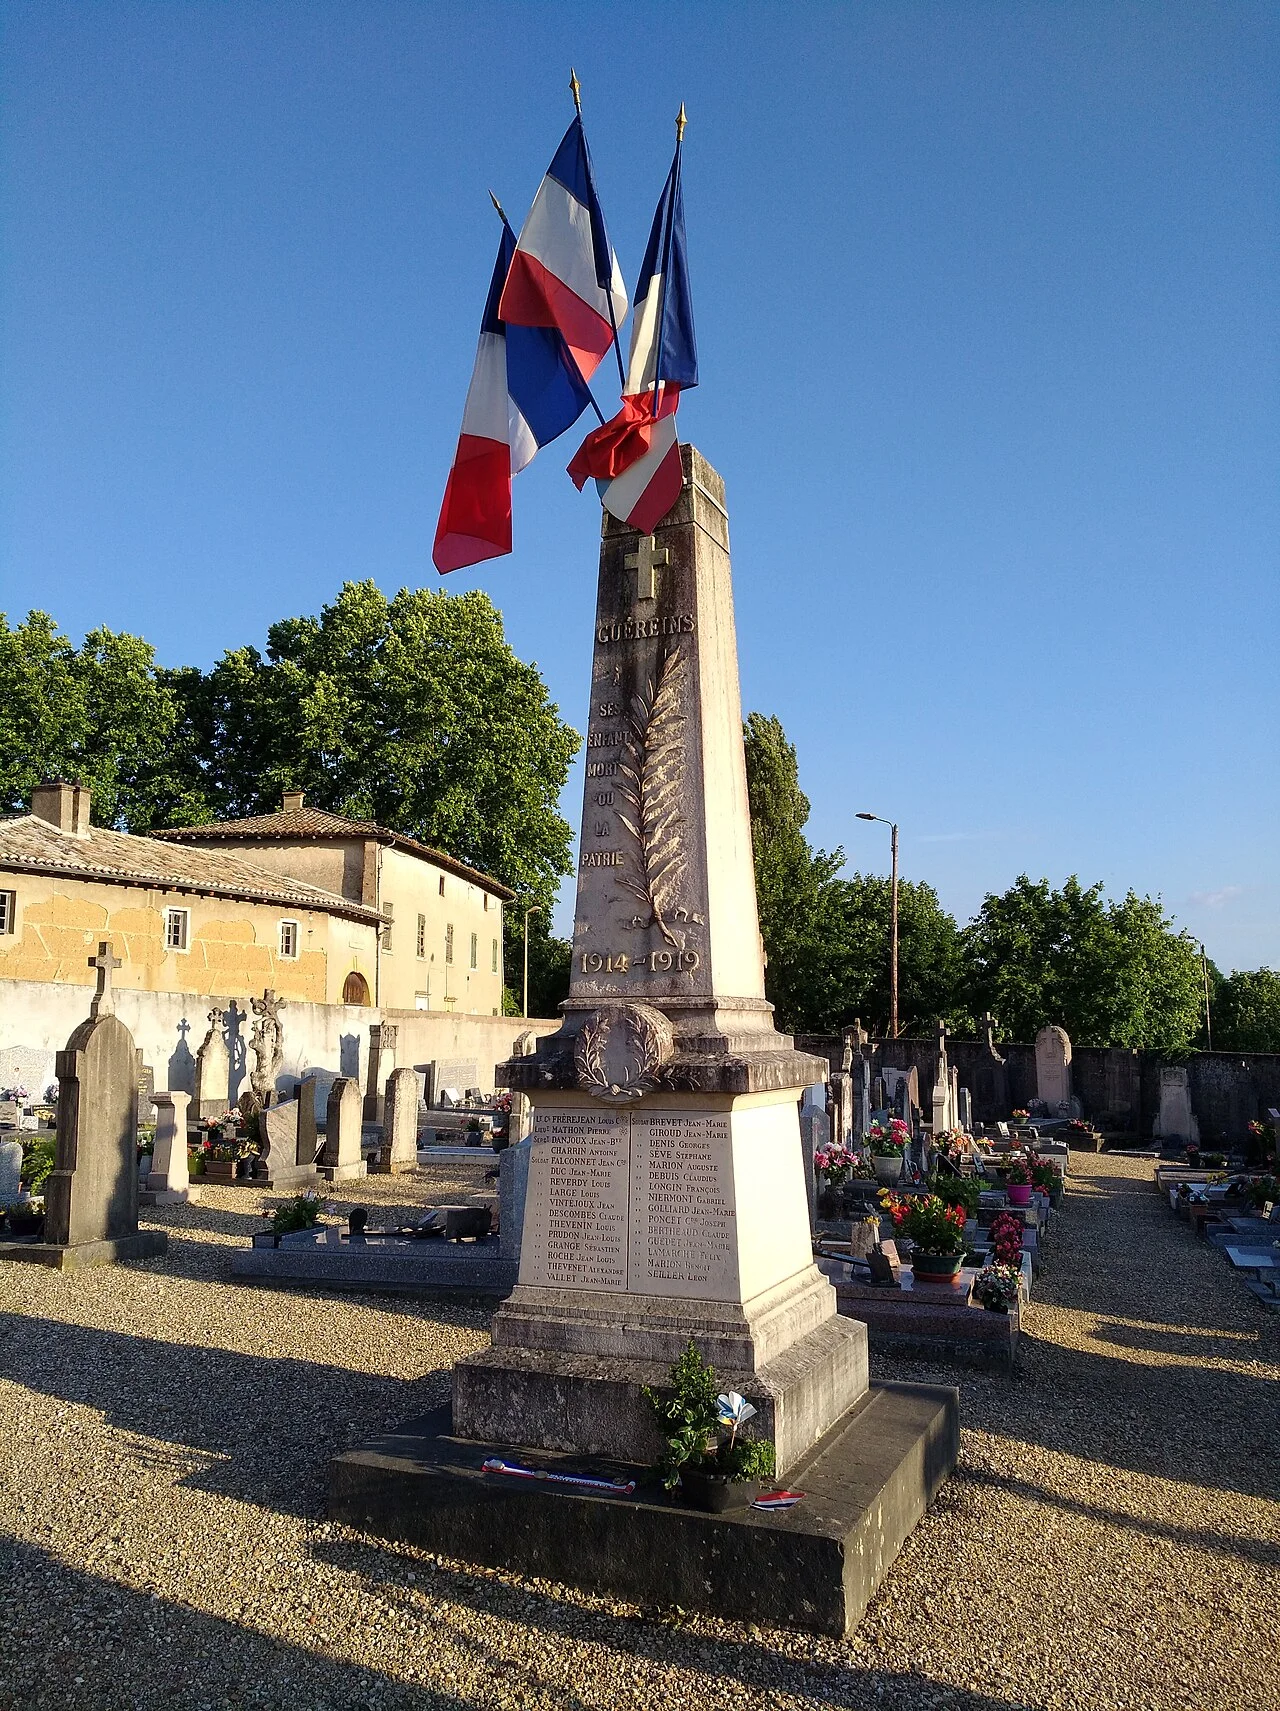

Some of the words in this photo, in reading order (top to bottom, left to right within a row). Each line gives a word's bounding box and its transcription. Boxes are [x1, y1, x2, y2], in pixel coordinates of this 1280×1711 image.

[600, 702, 620, 717] SES
[595, 822, 610, 836] LA
[581, 851, 624, 867] PATRIE
[649, 1117, 684, 1127] BREVET
[551, 1126, 585, 1135] MATHON
[649, 1128, 682, 1138] GIROUD
[551, 1136, 587, 1145] DANJOUX
[649, 1139, 675, 1148] DENIS
[551, 1146, 587, 1155] CHARRIN
[551, 1157, 597, 1166] FALCONNET
[649, 1160, 683, 1170] MARION
[550, 1167, 566, 1176] DUC
[649, 1171, 680, 1180] DEBUIS
[550, 1177, 588, 1187] REVERDY
[649, 1182, 682, 1191] LONGIN
[549, 1188, 577, 1197] LARGE
[648, 1193, 694, 1203] NIERMONT
[648, 1204, 690, 1214] GOLLIARD
[549, 1209, 596, 1220] DESCOMBES
[648, 1215, 682, 1225] PONCET
[548, 1230, 580, 1240] PRUDON
[547, 1240, 580, 1250] GRANGE
[547, 1251, 575, 1261] ROCHE
[547, 1262, 588, 1272] THEVENET
[647, 1258, 682, 1268] MARION
[546, 1272, 577, 1282] VALLET
[647, 1269, 685, 1280] SEILLER
